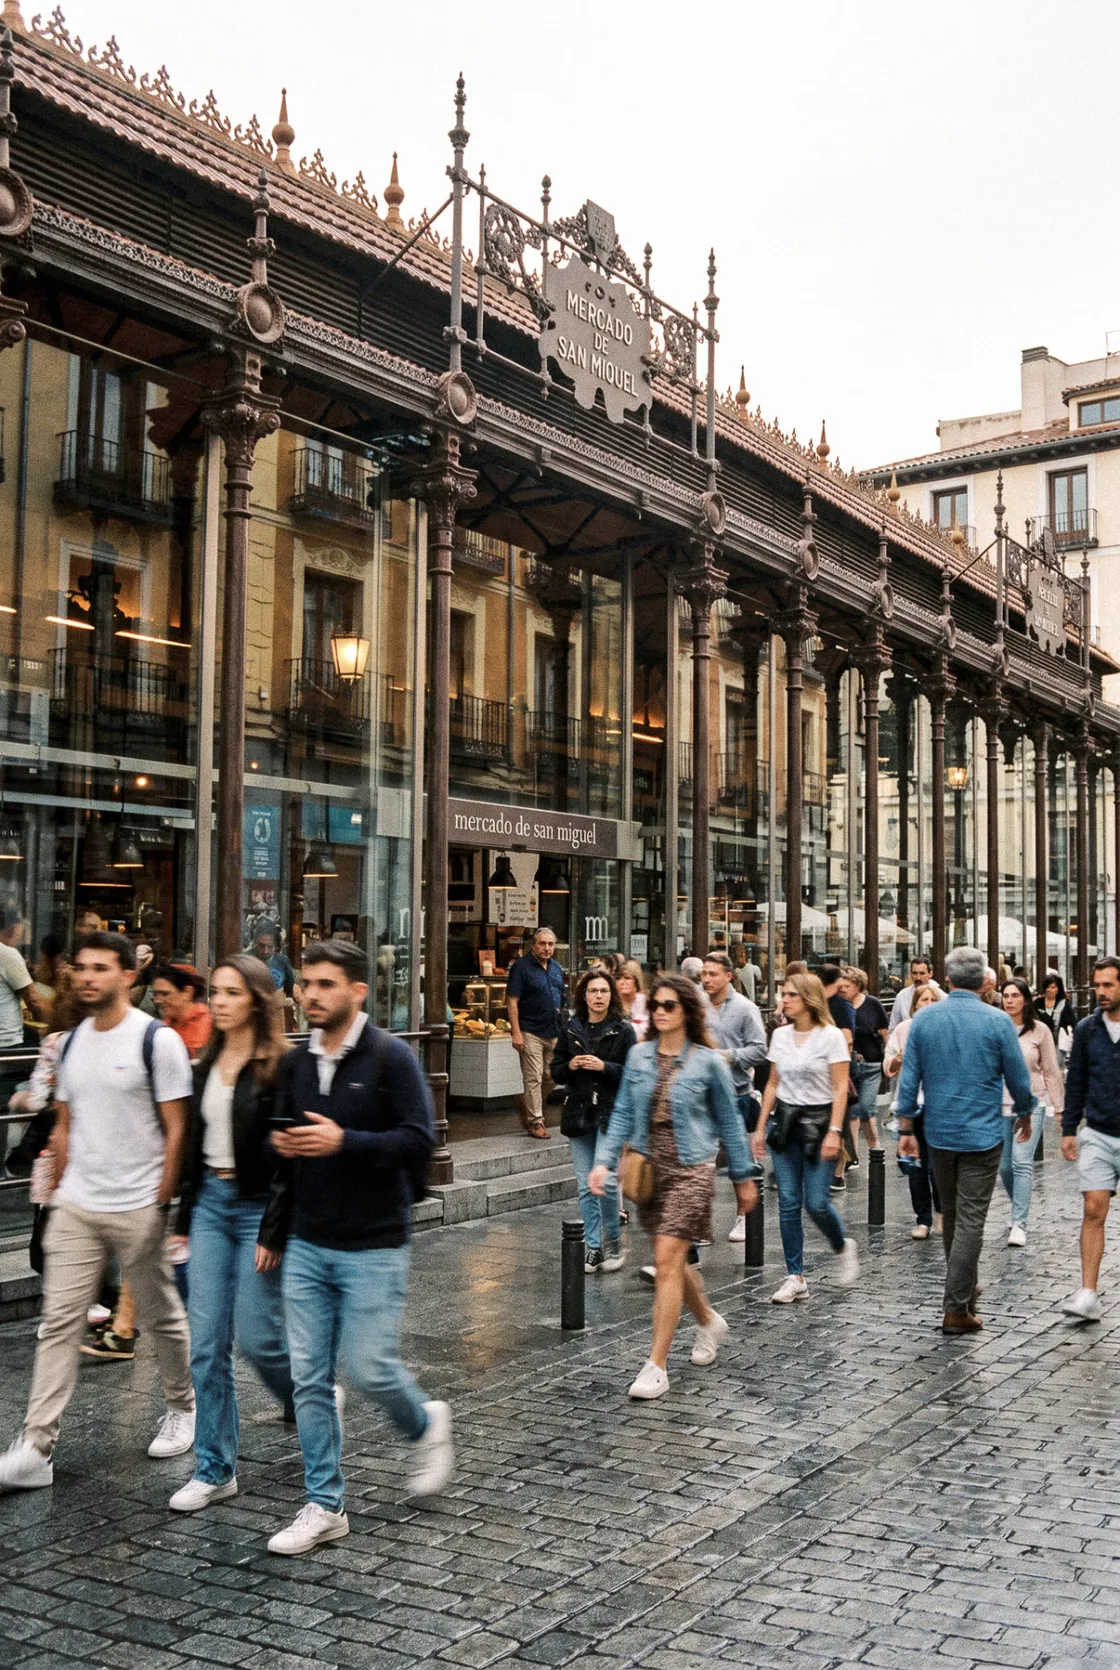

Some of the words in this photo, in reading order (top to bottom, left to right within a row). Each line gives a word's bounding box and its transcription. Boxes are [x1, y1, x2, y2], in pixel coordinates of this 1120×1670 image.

[567, 289, 633, 345] MERCADO
[557, 336, 587, 370] SAN
[593, 332, 609, 356] DE
[454, 813, 512, 835] mercado
[515, 815, 531, 837] de
[533, 821, 554, 840] san
[557, 822, 597, 849] miguel
[584, 916, 608, 941] m
